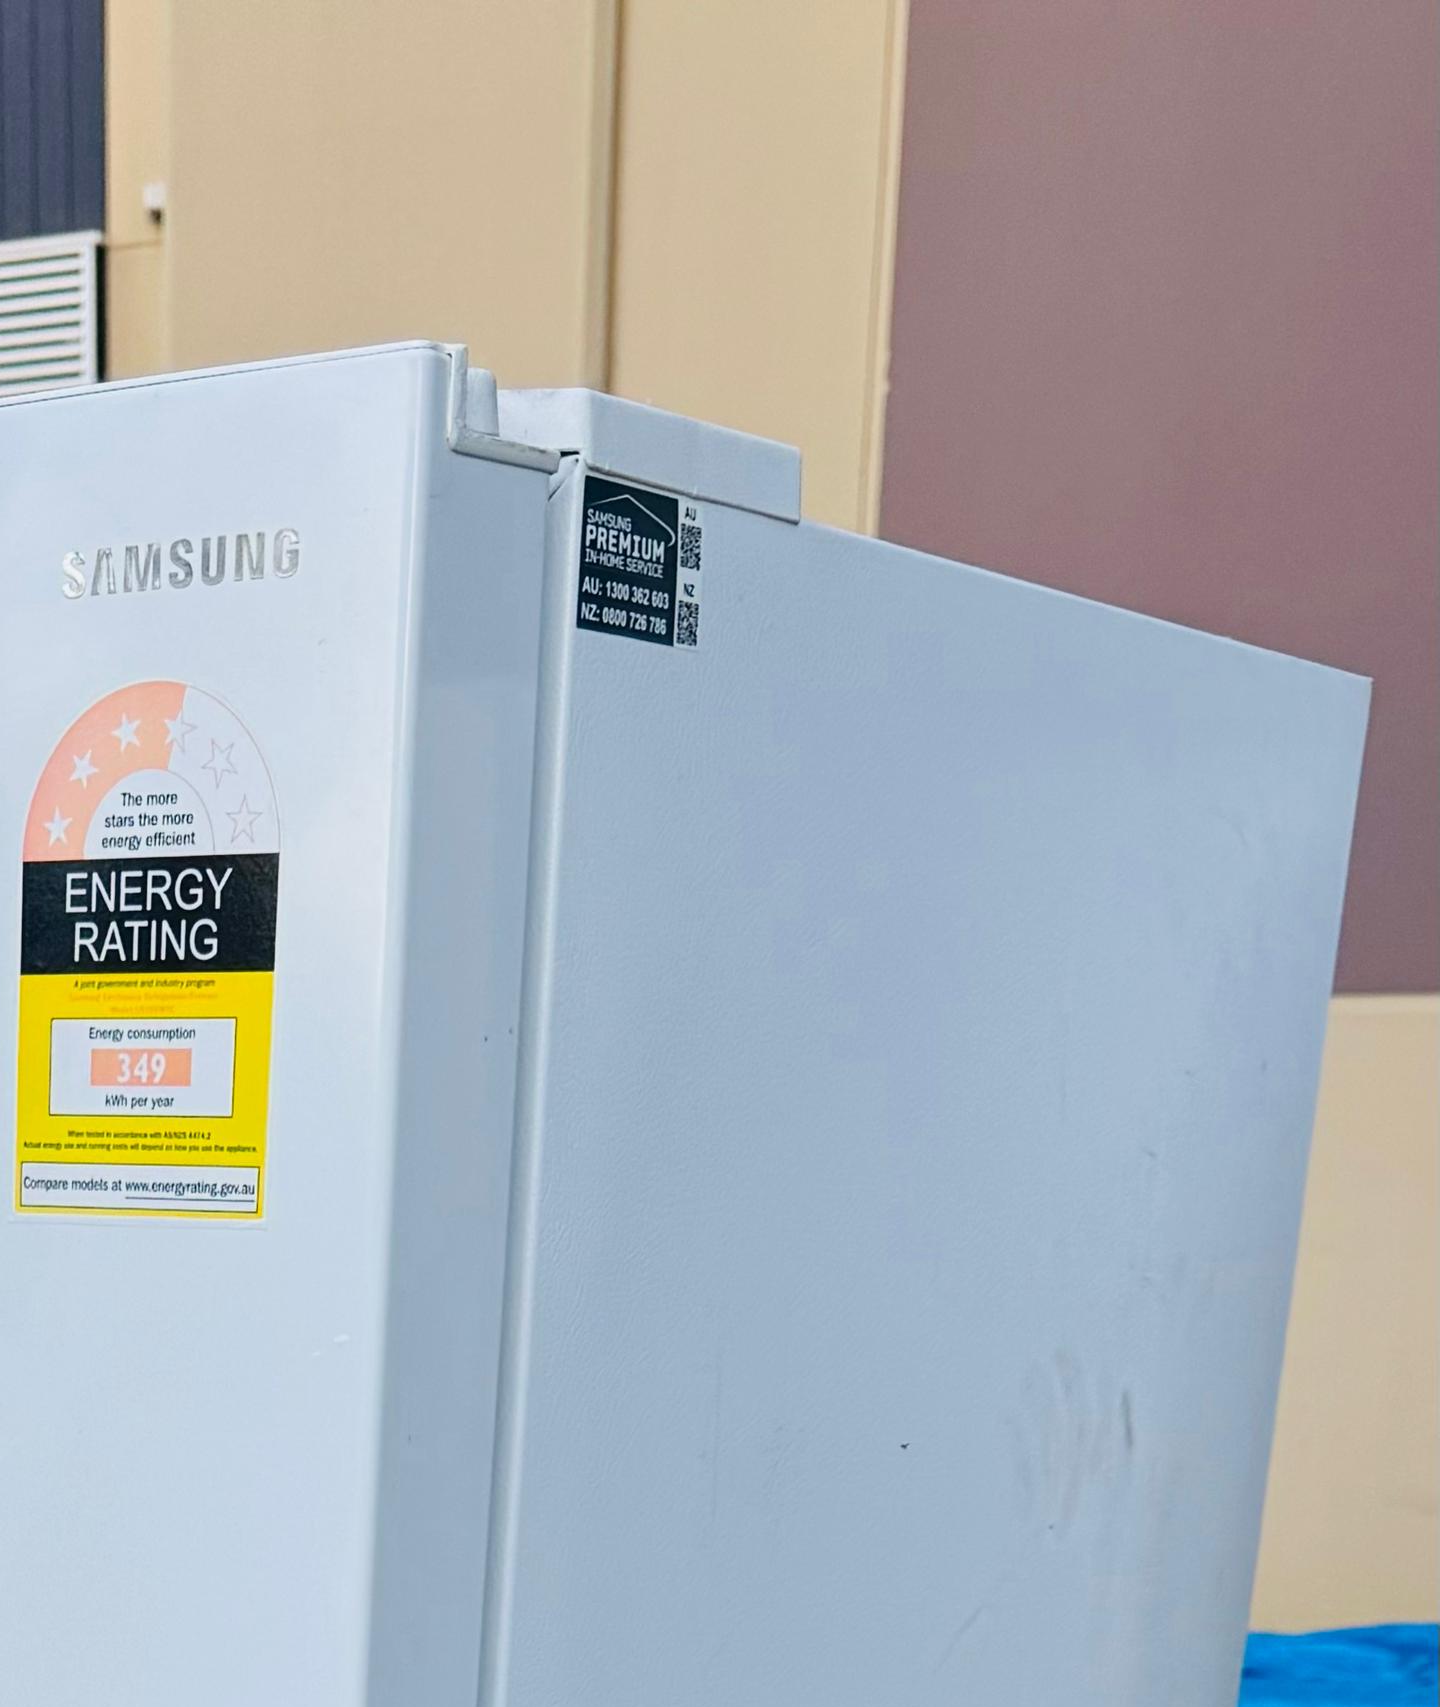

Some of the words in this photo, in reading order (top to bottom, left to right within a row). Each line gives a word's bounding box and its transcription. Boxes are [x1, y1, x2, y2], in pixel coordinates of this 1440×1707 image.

[587, 508, 632, 532] SAMSUNG
[685, 506, 697, 522] AU
[585, 524, 665, 563] PREMIUM
[61, 527, 300, 600] SAMSUNG
[585, 548, 625, 571] IN-HOME
[626, 558, 664, 579] SERVICE
[582, 576, 603, 596] AU:
[605, 581, 629, 601] 1300
[631, 587, 650, 606] 362
[652, 591, 669, 610] 603
[683, 583, 695, 598] NZ
[581, 602, 600, 622] NZ:
[602, 607, 627, 627] 0800
[629, 612, 647, 631] 726
[649, 616, 667, 635] 786
[121, 792, 142, 807] The
[146, 792, 178, 806] more
[104, 815, 134, 828] stars
[138, 813, 158, 826] the
[162, 812, 194, 826] more
[101, 835, 142, 851] energy
[146, 831, 195, 847] efficient
[65, 867, 233, 914] ENERGY
[73, 918, 219, 963] RATING
[88, 1026, 124, 1042] Energy
[127, 1026, 196, 1042] consumption
[116, 1052, 167, 1085] 349
[105, 1094, 127, 1107] kWh
[130, 1096, 148, 1110] per
[151, 1097, 174, 1110] year
[23, 1175, 68, 1192] Compare
[71, 1177, 109, 1192] models
[111, 1179, 122, 1192] at
[125, 1180, 255, 1198] www.energyrating.gov.au
